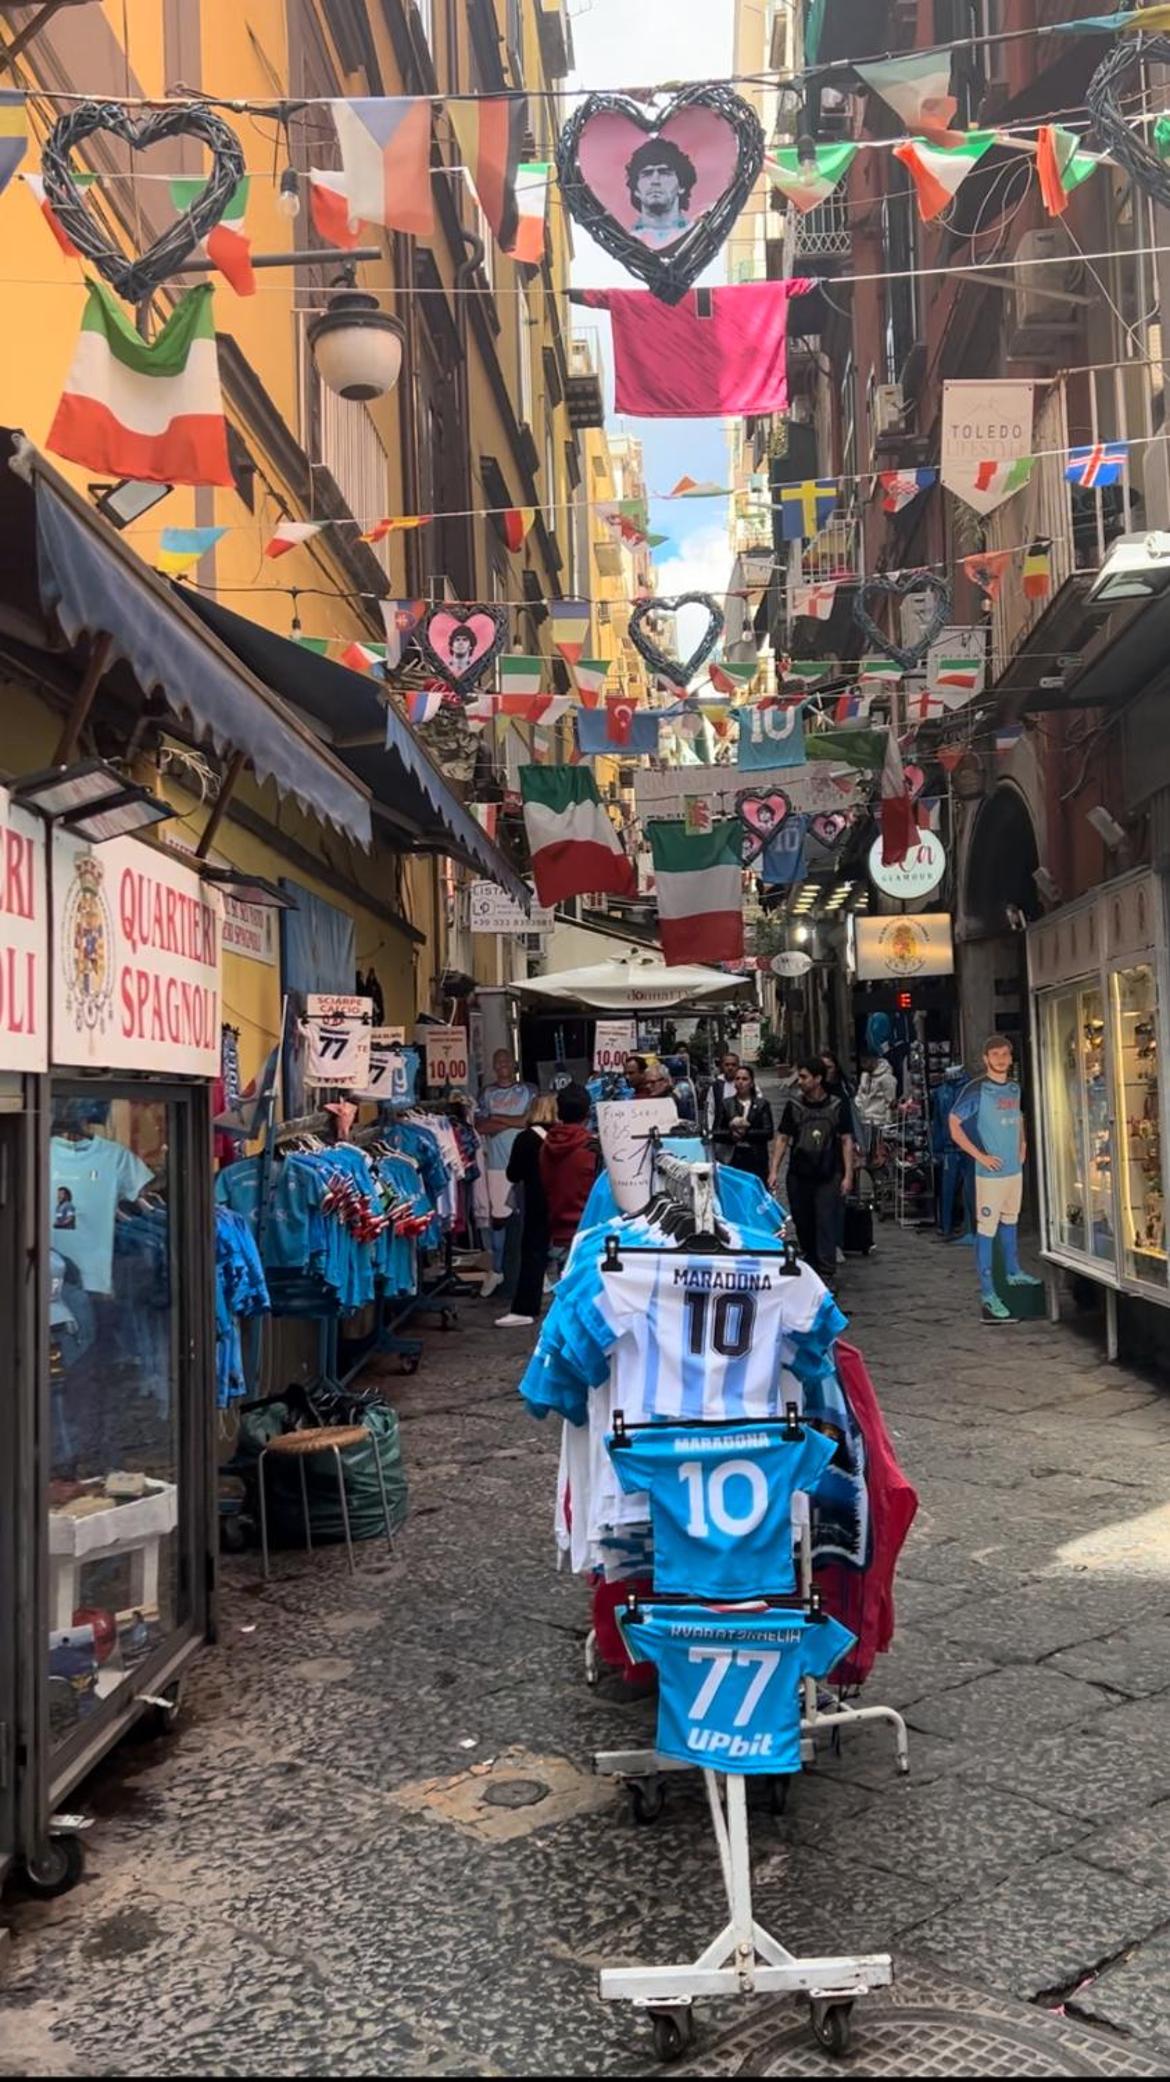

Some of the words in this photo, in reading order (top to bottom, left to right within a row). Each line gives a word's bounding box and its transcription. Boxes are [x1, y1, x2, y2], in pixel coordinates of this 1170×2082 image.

[951, 425, 1022, 439] TOLEDO
[0, 825, 35, 921] RI
[119, 866, 217, 969] QUARTIERI
[0, 947, 36, 1035] LI
[120, 965, 217, 1051] SPAGNOLI
[319, 1036, 349, 1060] 77
[673, 1268, 772, 1291] MARADONA
[683, 1290, 758, 1361] 10
[674, 1432, 771, 1452] MARADONA
[678, 1459, 768, 1538] 10
[688, 1646, 781, 1728] 77
